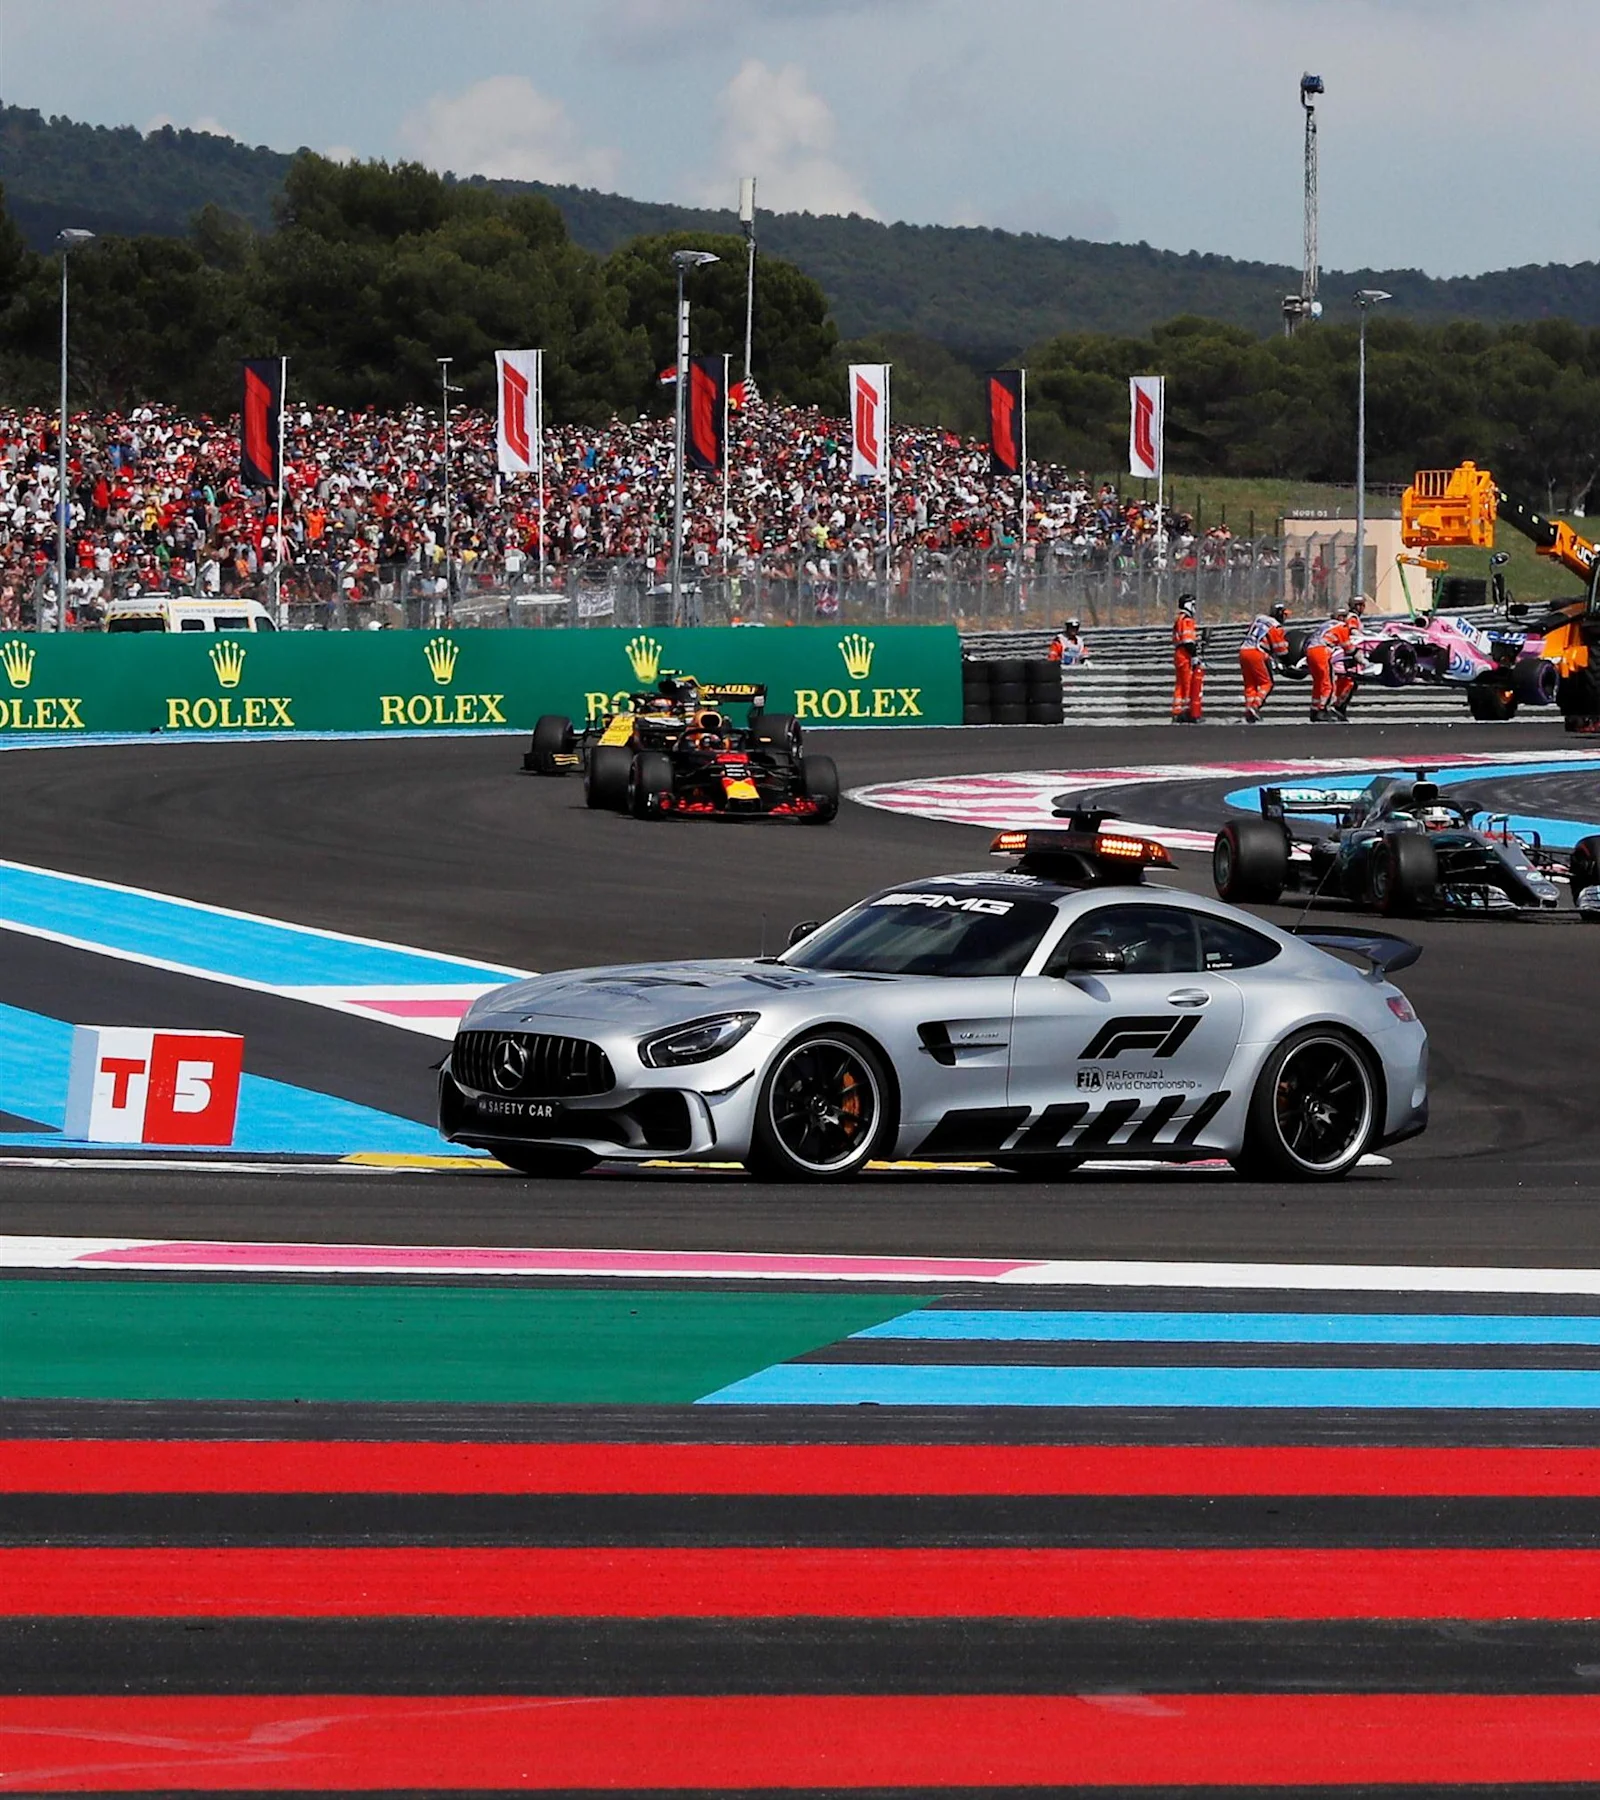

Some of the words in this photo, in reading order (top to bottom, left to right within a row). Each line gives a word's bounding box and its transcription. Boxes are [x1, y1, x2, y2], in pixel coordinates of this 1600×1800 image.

[1577, 546, 1597, 567] JC
[166, 697, 295, 729] ROLEX
[380, 694, 507, 726] ROLEX
[794, 687, 923, 719] ROLEX
[899, 893, 1015, 916] AMG
[1106, 1071, 1120, 1079] FIA
[1122, 1070, 1158, 1079] Formula
[1106, 1080, 1132, 1090] World
[1133, 1080, 1196, 1090] Championship
[488, 1101, 524, 1115] SAFETY
[529, 1104, 552, 1117] CAR
